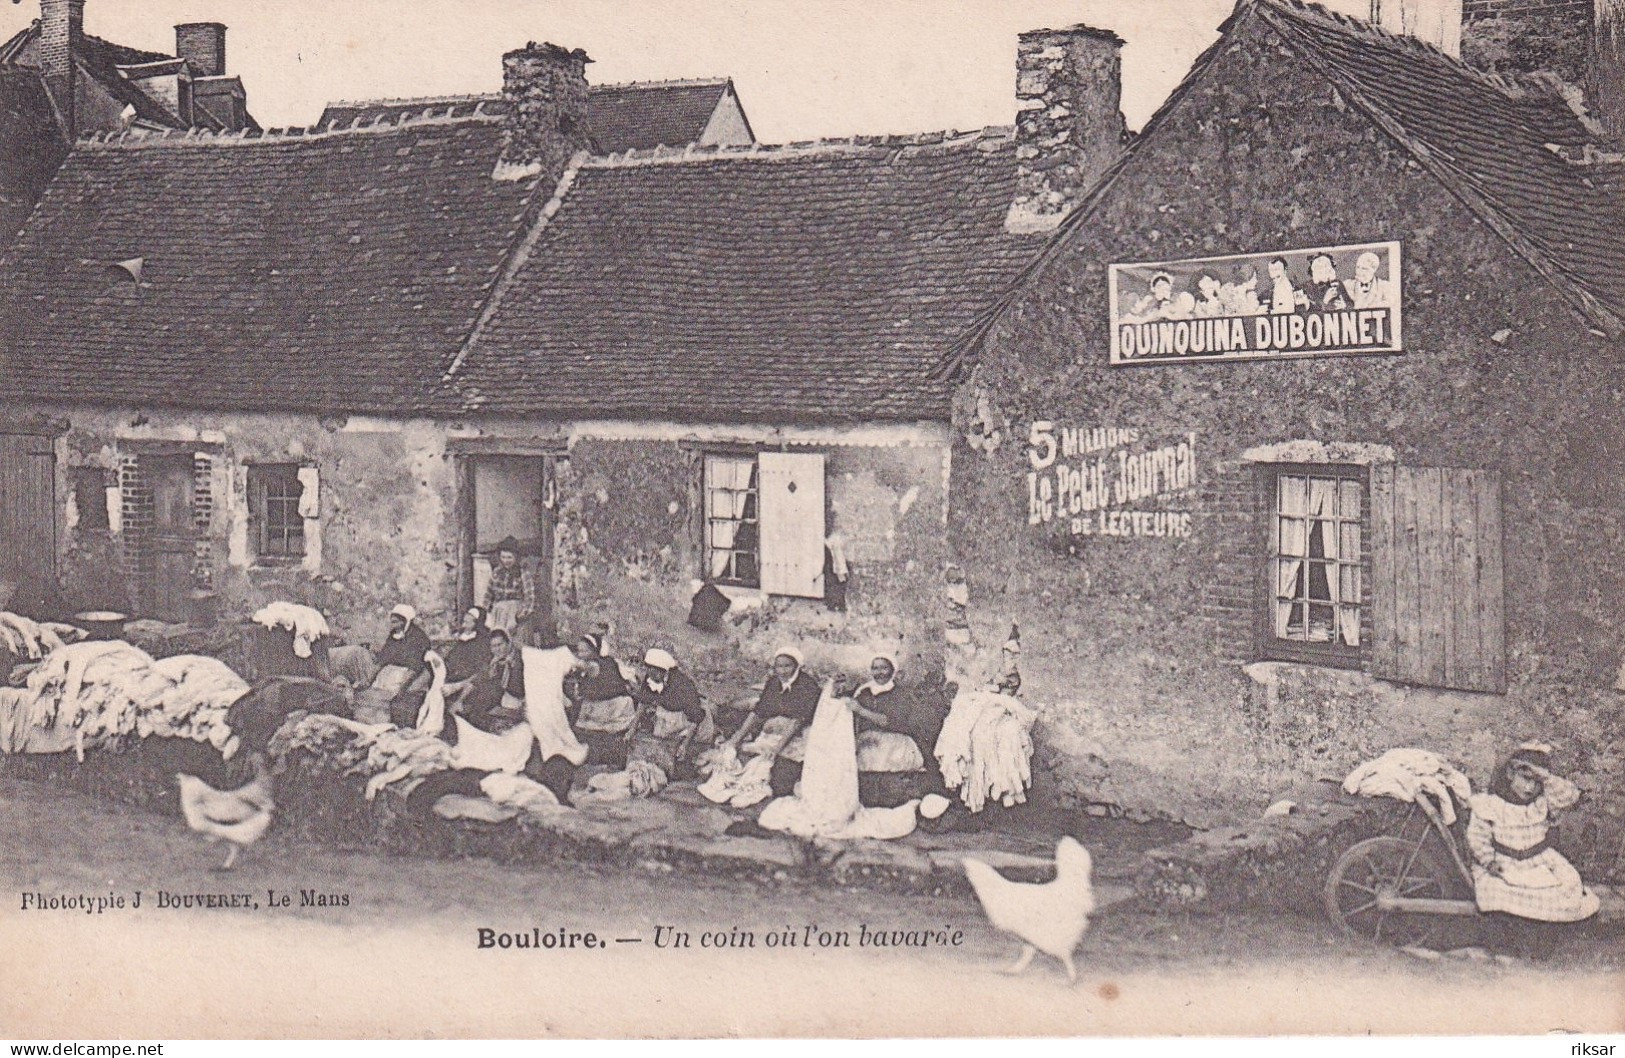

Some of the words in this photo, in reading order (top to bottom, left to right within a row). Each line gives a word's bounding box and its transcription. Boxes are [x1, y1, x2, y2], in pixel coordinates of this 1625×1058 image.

[1121, 318, 1247, 358] QUINQUINA
[1255, 310, 1386, 349] DUBONNET
[1028, 420, 1057, 470] 5
[1028, 472, 1052, 525] Le
[1056, 457, 1109, 518] Petit
[1112, 432, 1196, 504] Journal
[1071, 518, 1092, 535] DE
[1099, 510, 1192, 537] LECTEURS
